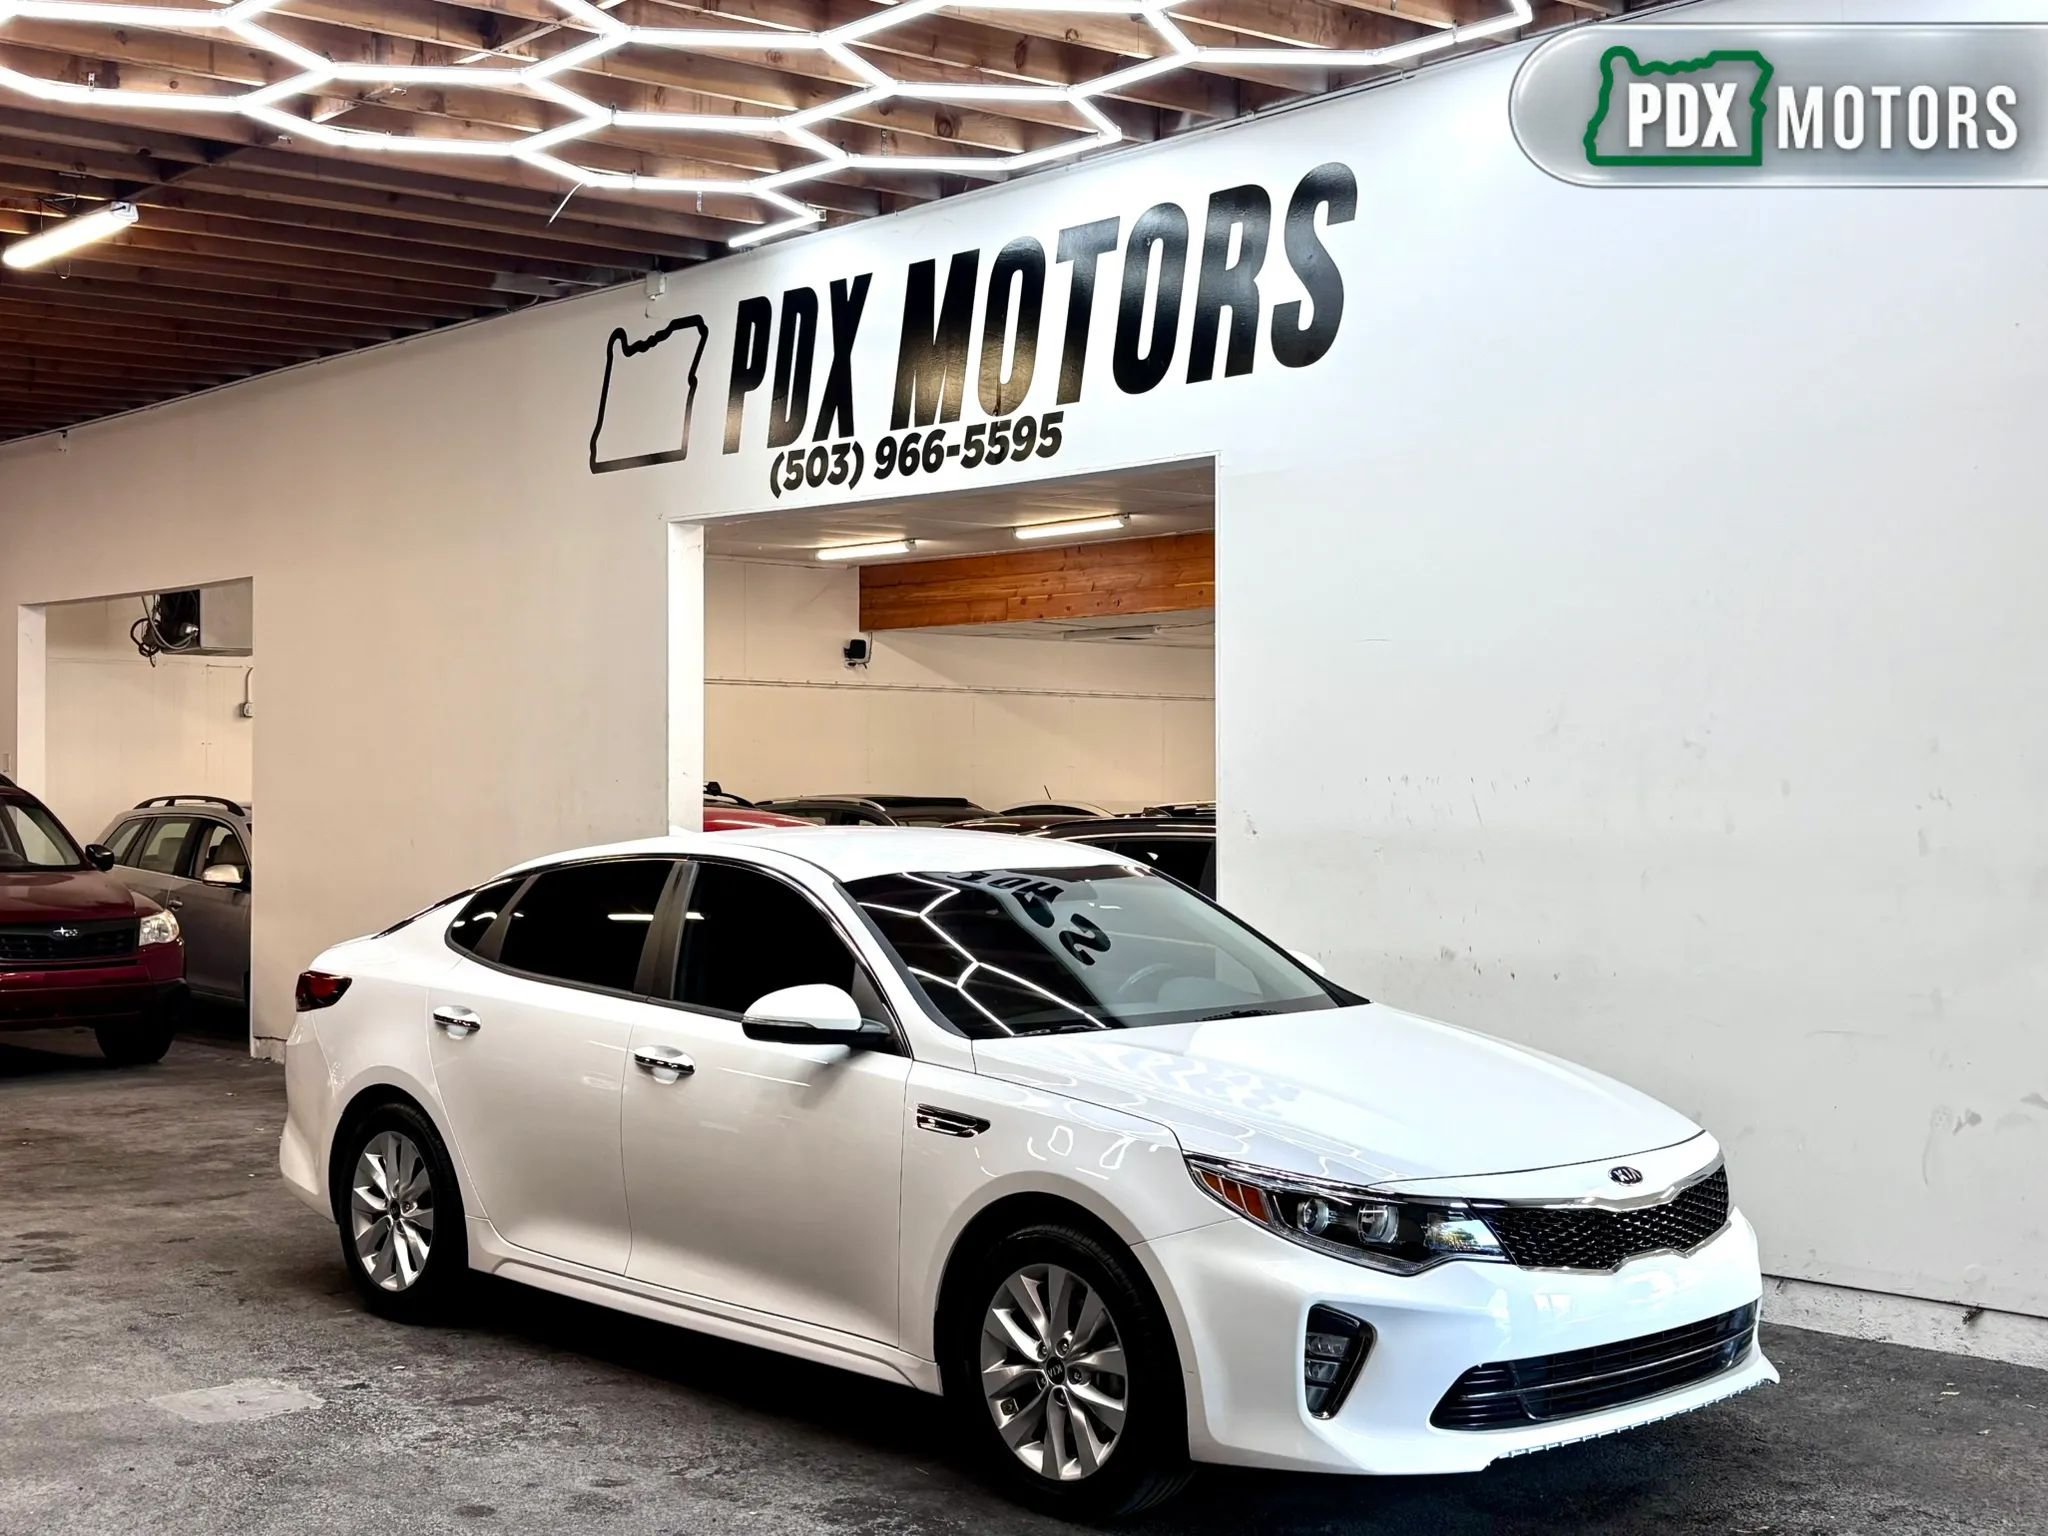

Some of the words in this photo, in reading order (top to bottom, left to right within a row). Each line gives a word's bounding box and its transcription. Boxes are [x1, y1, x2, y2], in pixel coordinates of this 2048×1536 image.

[722, 272, 873, 455] PDX
[889, 161, 1358, 431] MOTORS
[768, 441, 865, 499] (503)
[872, 411, 1065, 481] 966-5595
[1611, 1167, 1641, 1182] KIA
